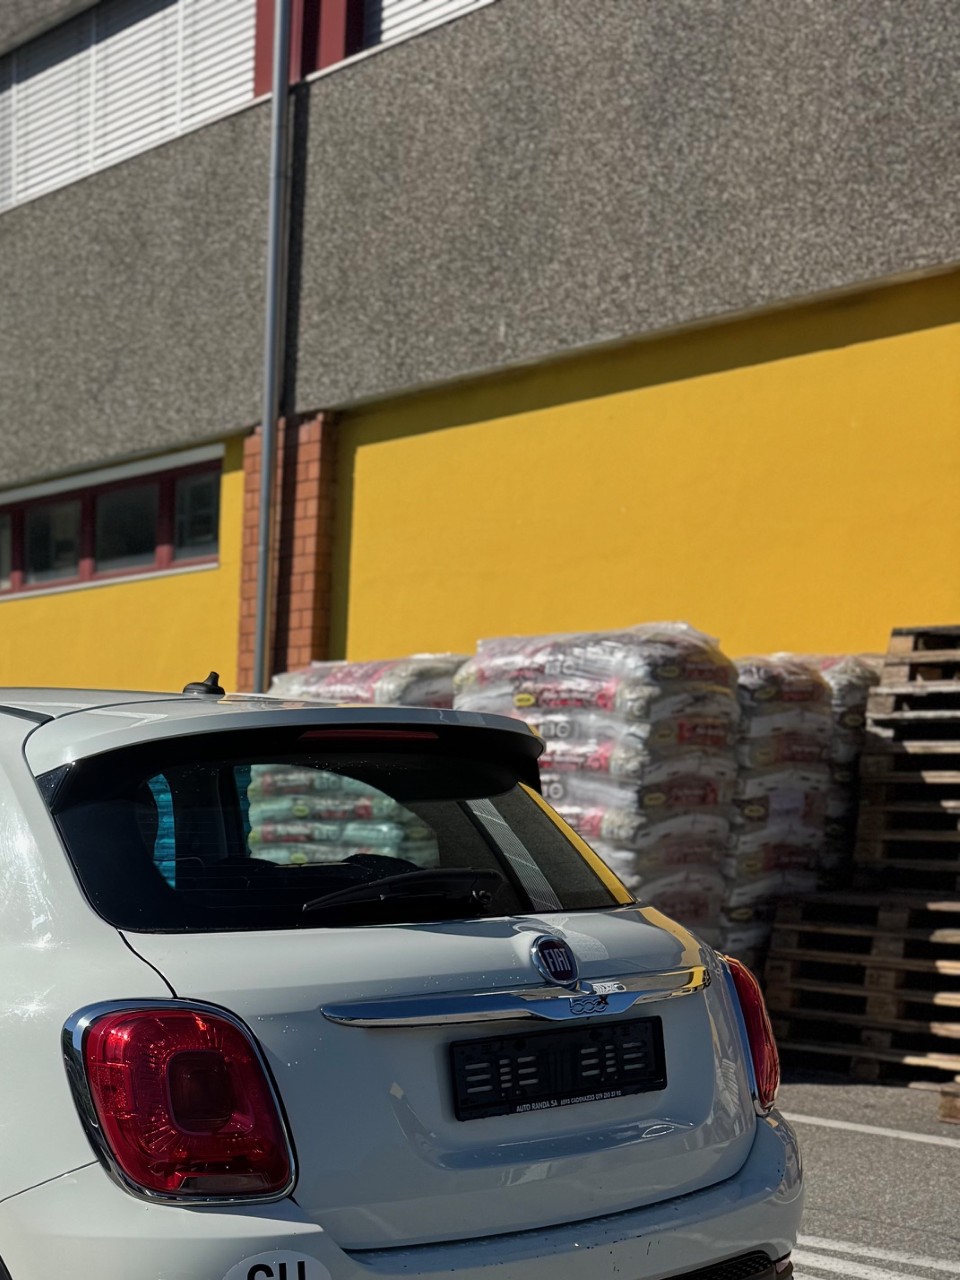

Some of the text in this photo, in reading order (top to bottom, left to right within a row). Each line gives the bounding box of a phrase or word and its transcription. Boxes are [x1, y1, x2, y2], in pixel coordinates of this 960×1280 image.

[544, 948, 572, 972] FIAT
[516, 1103, 531, 1112] AUTO
[531, 1100, 550, 1110] RANDA
[550, 1099, 558, 1107] SA
